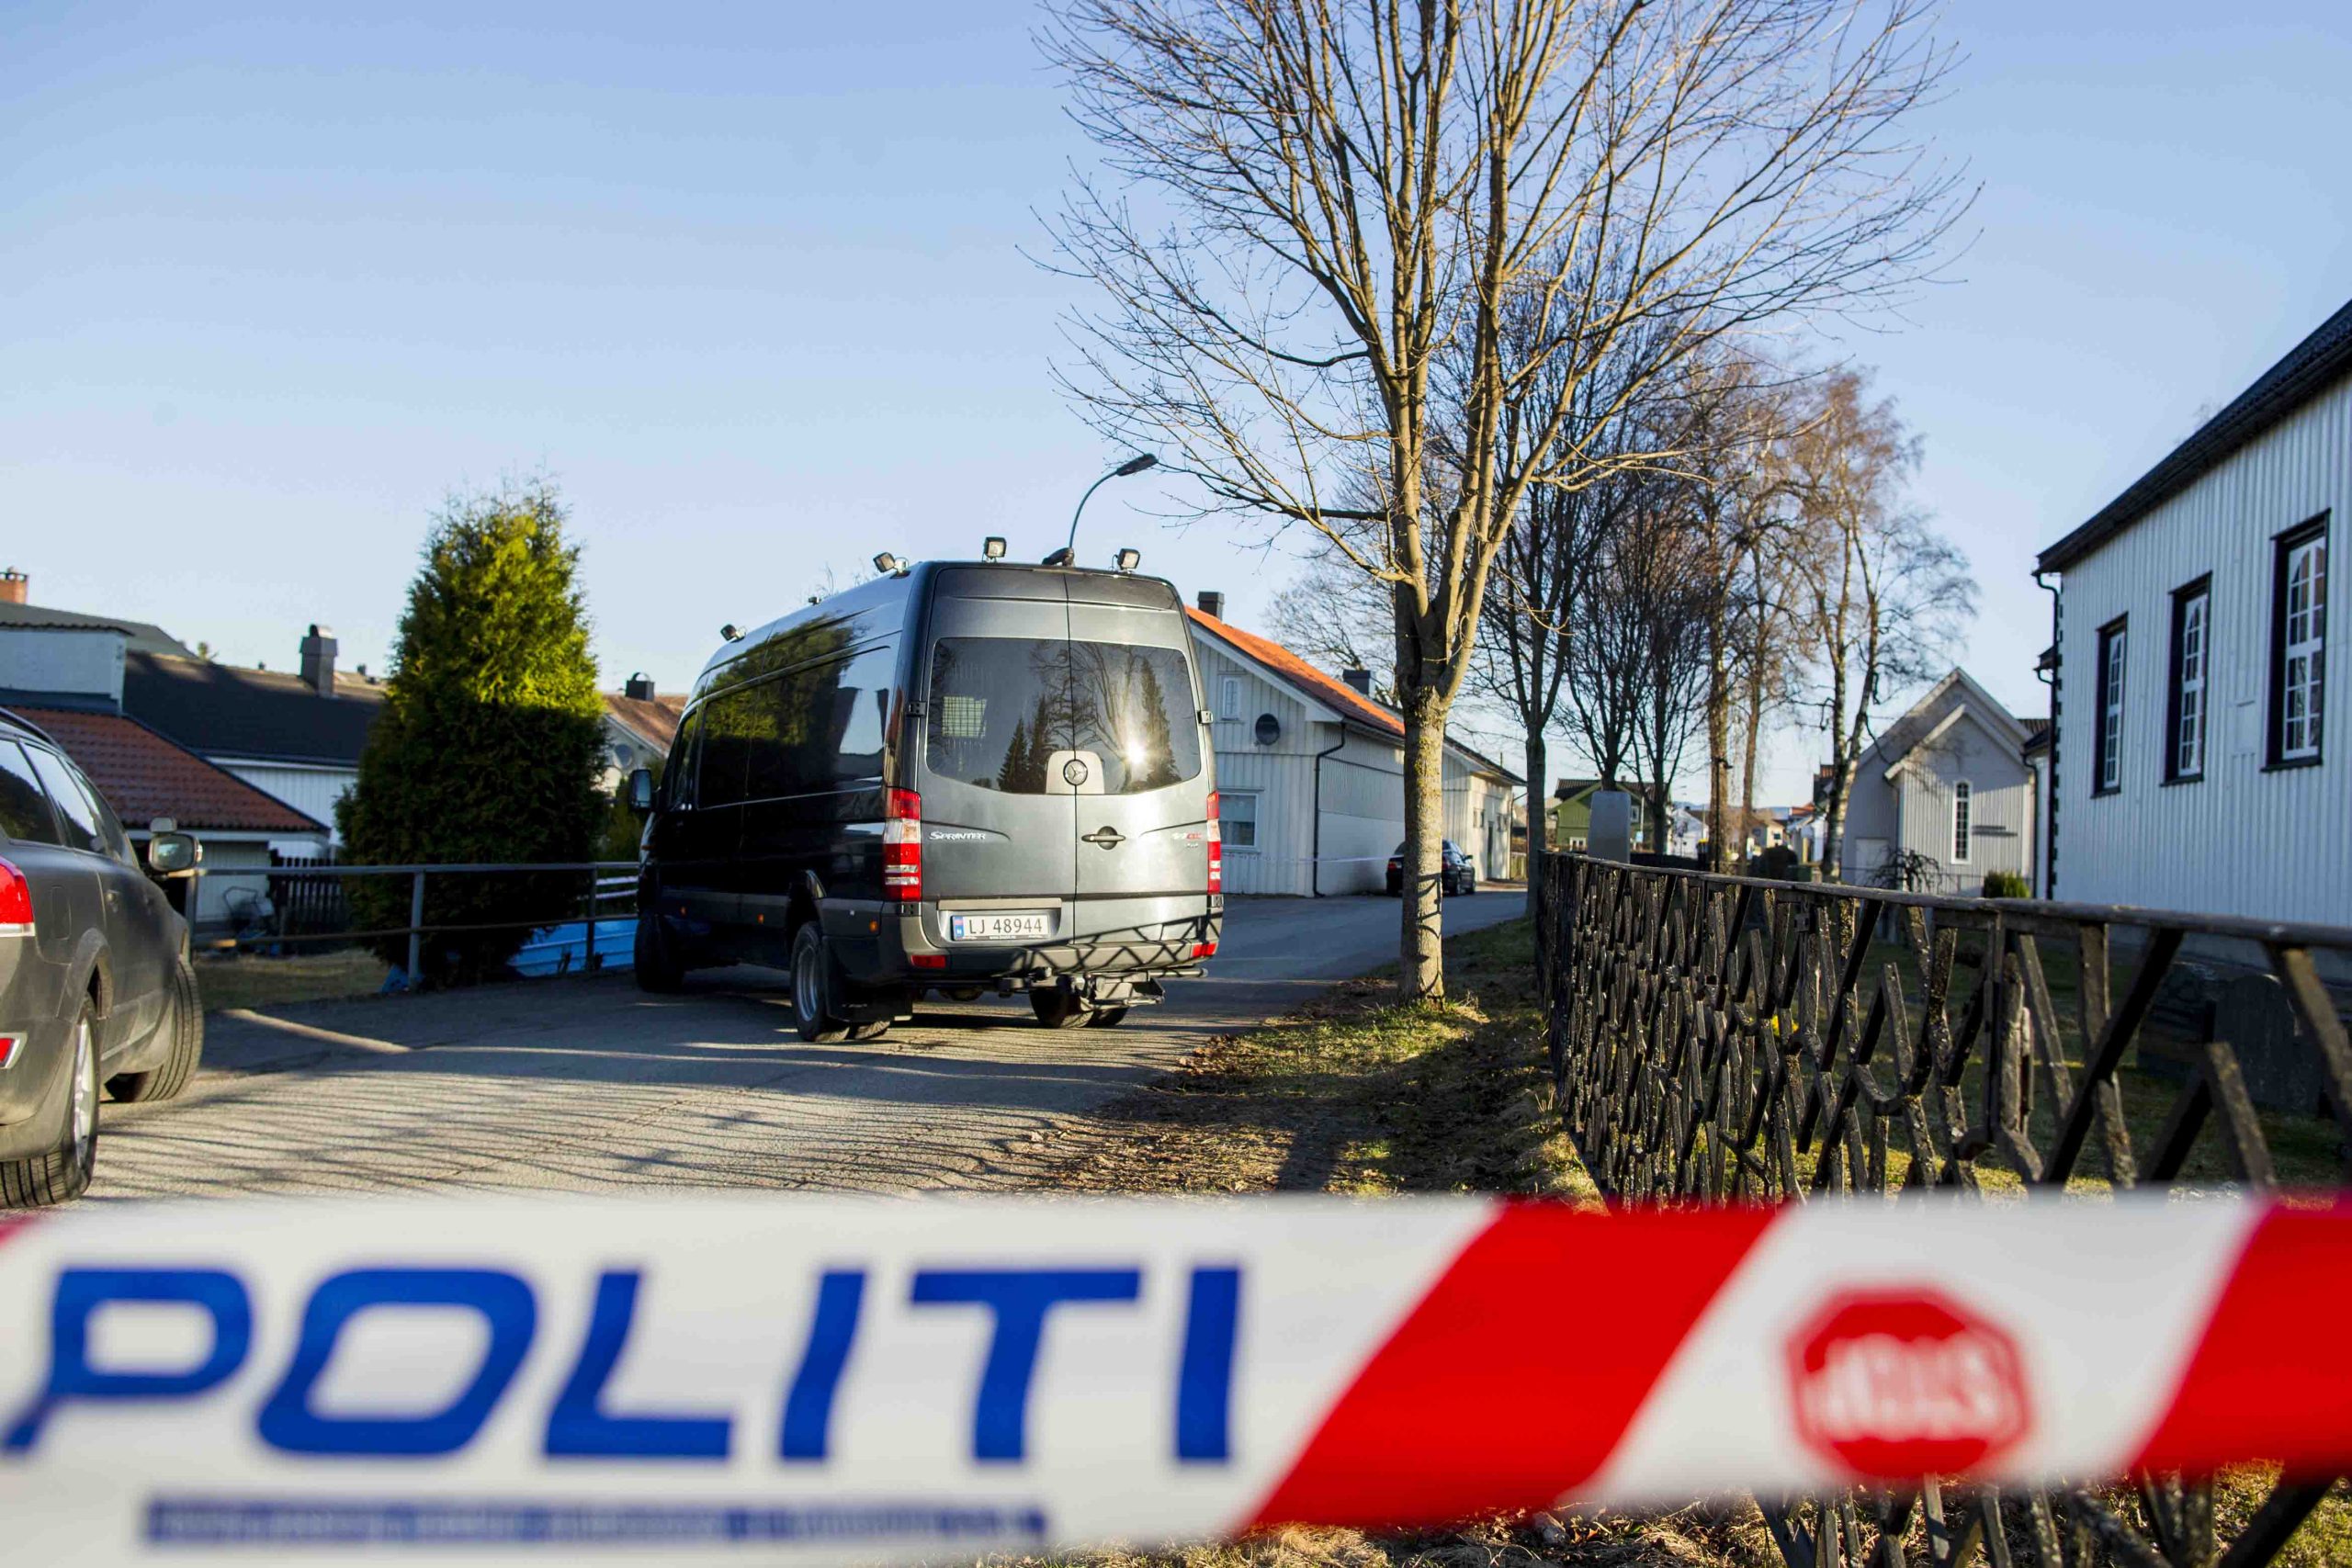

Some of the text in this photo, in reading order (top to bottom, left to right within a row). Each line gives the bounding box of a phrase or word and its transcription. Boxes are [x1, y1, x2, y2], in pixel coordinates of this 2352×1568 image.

[969, 919, 1043, 934] LJ 48944
[2, 1264, 1246, 1464] POLITI
